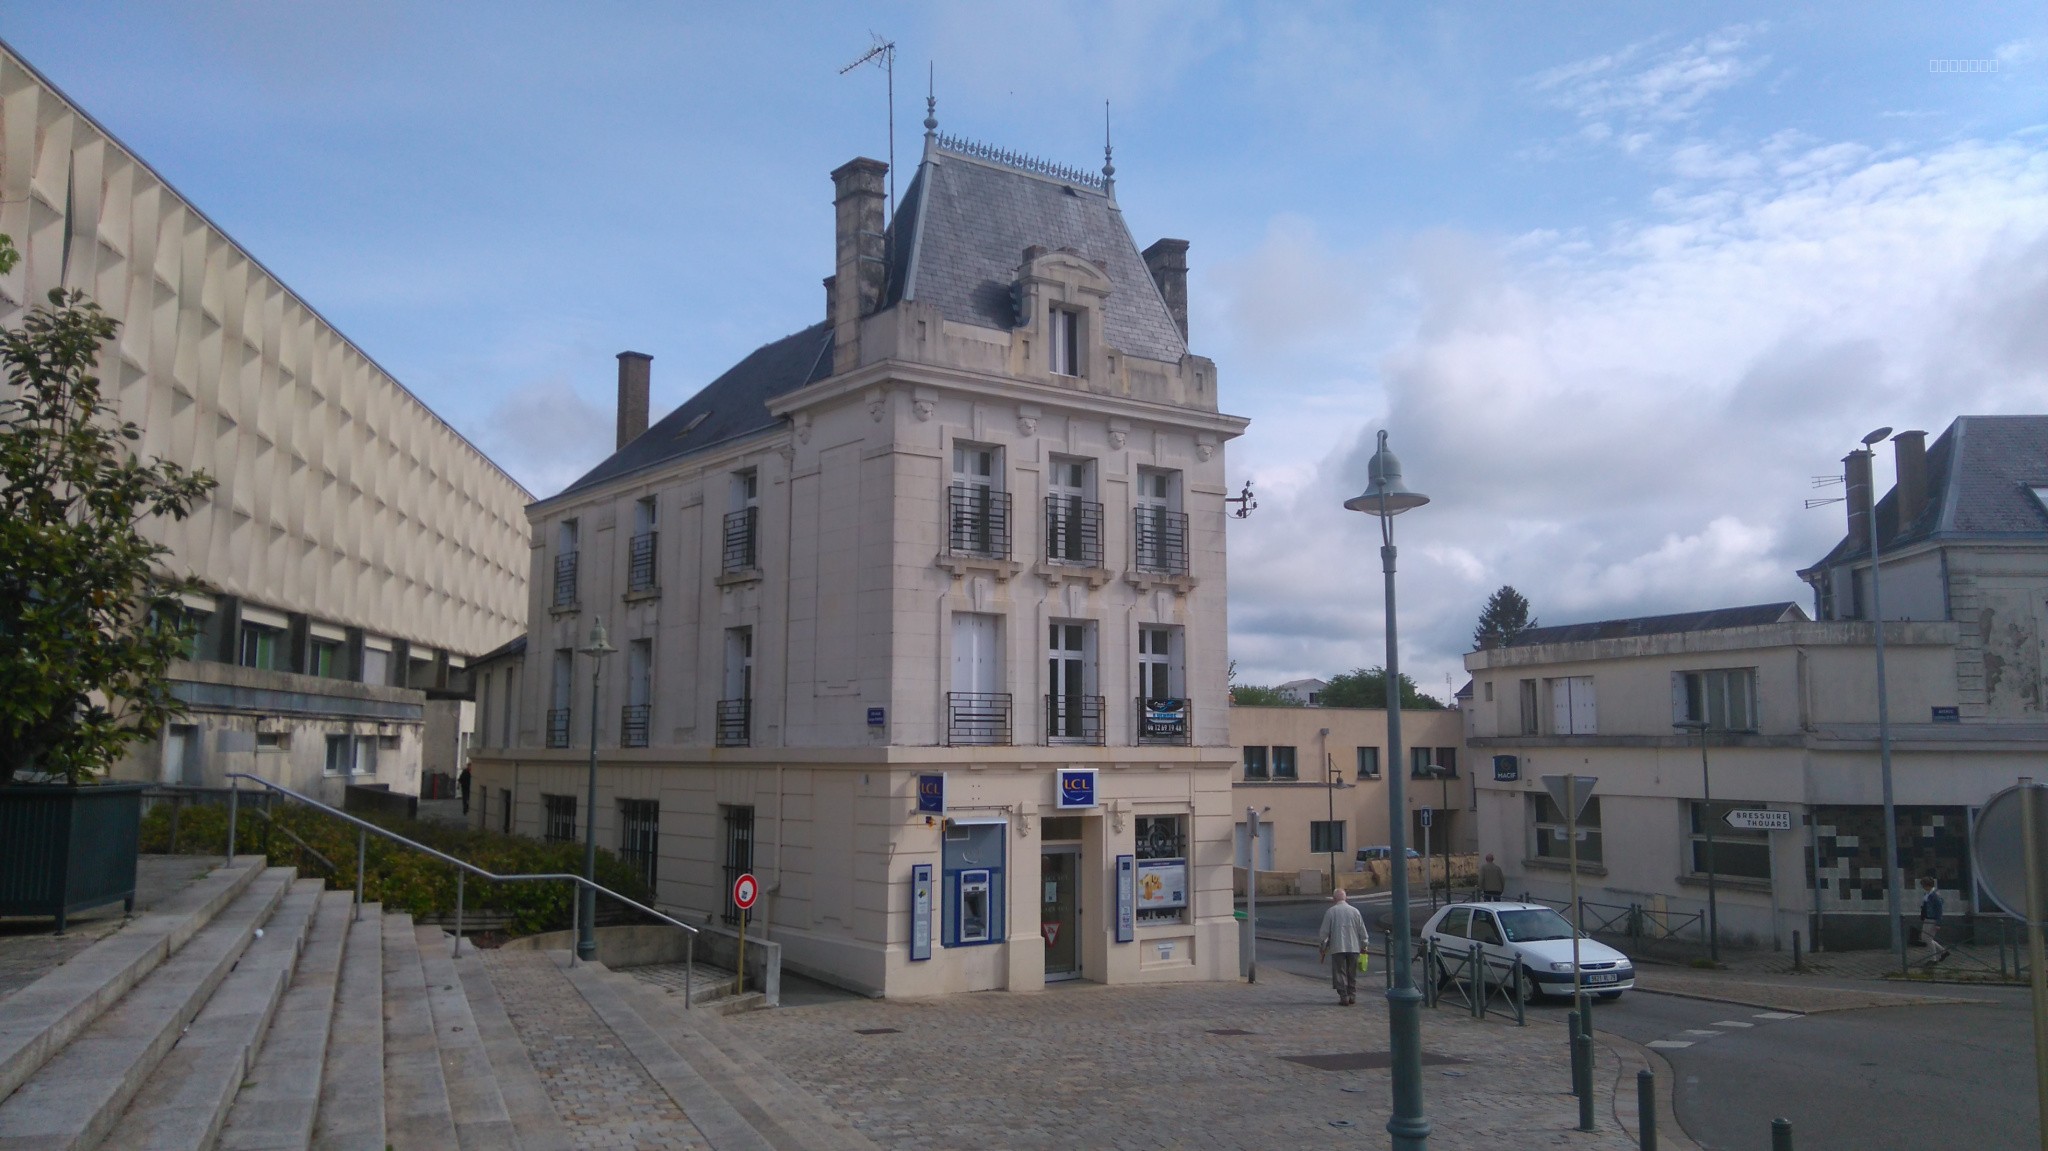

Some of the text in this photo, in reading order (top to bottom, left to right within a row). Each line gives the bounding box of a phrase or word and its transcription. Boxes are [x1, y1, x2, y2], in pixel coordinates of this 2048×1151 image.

[921, 782, 939, 794] LCL
[1064, 778, 1090, 790] LCL
[1736, 812, 1787, 820] BRESSUIRE
[1747, 820, 1788, 828] THOUARS
